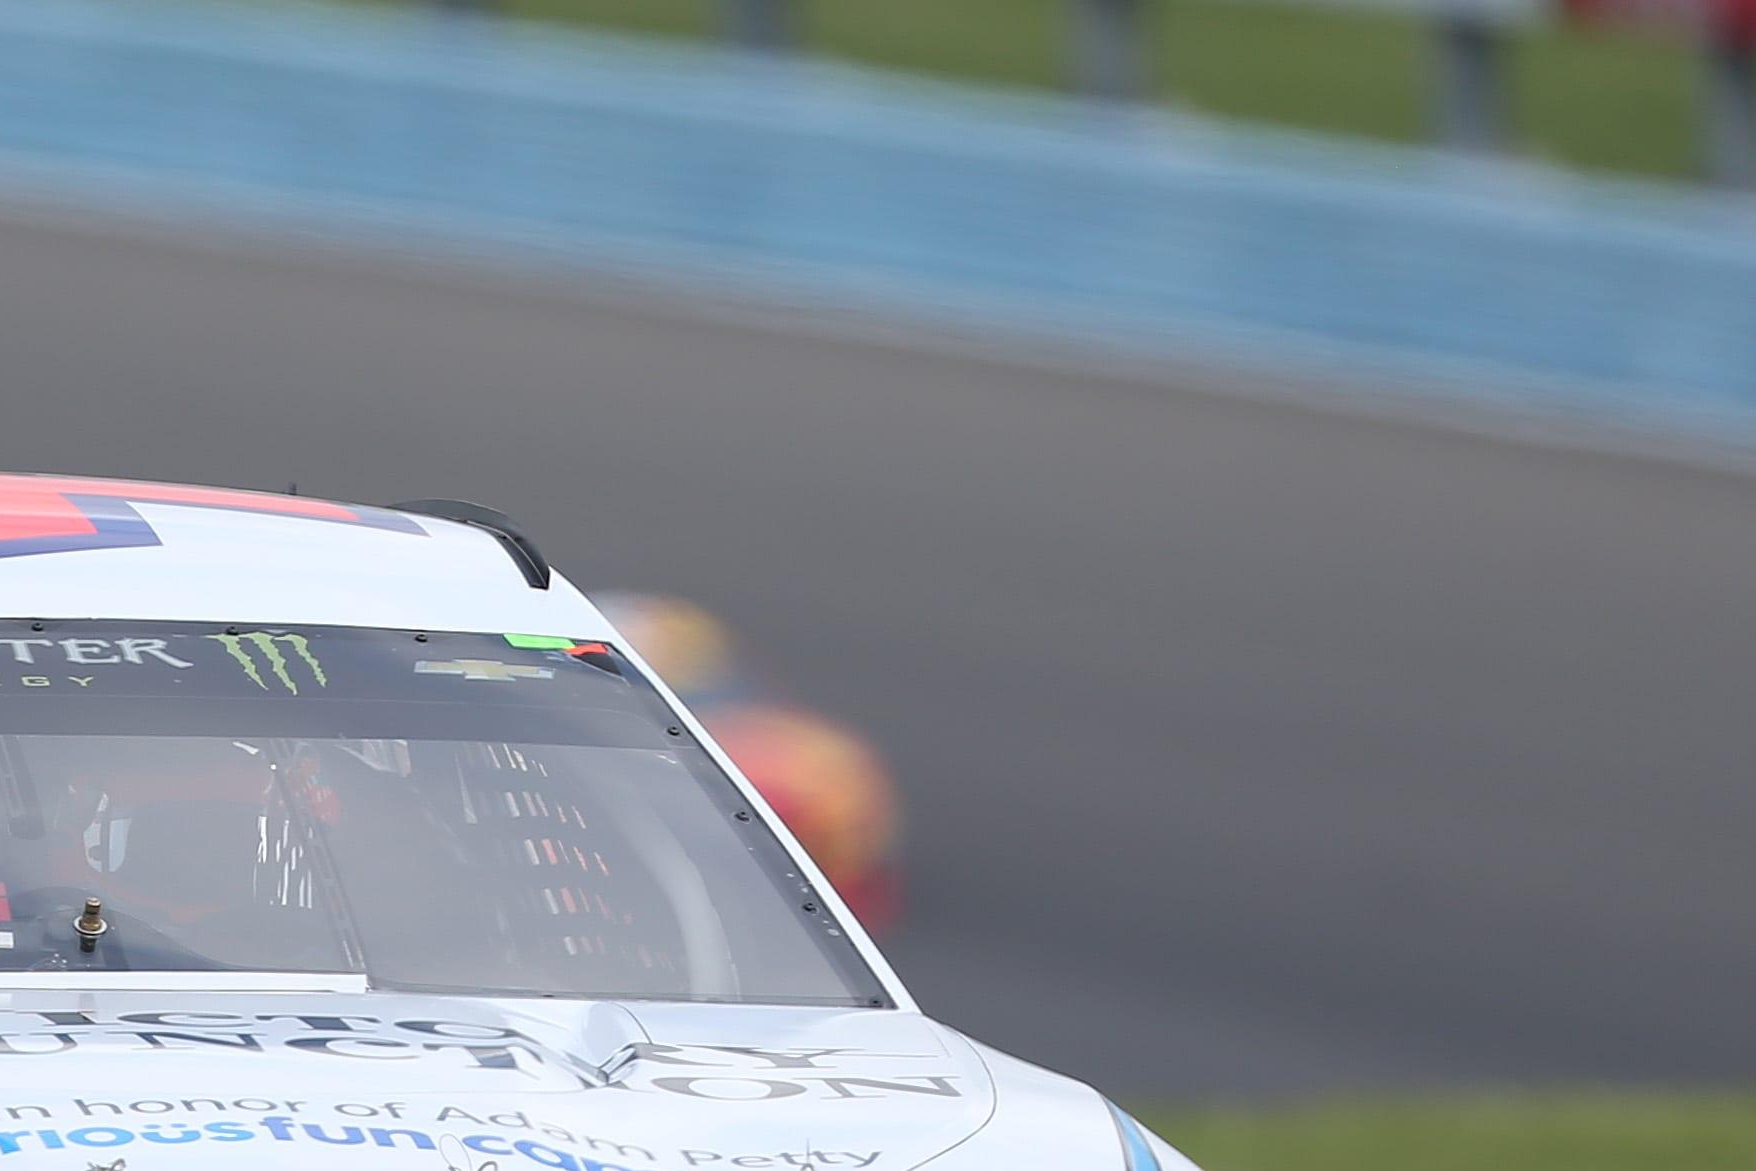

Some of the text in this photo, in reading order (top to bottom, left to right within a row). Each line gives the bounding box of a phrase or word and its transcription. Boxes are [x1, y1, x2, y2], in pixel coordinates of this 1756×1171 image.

[73, 1098, 307, 1117] honor
[333, 1101, 408, 1120] of
[437, 1105, 658, 1162] Adam
[681, 1148, 883, 1168] Petty
